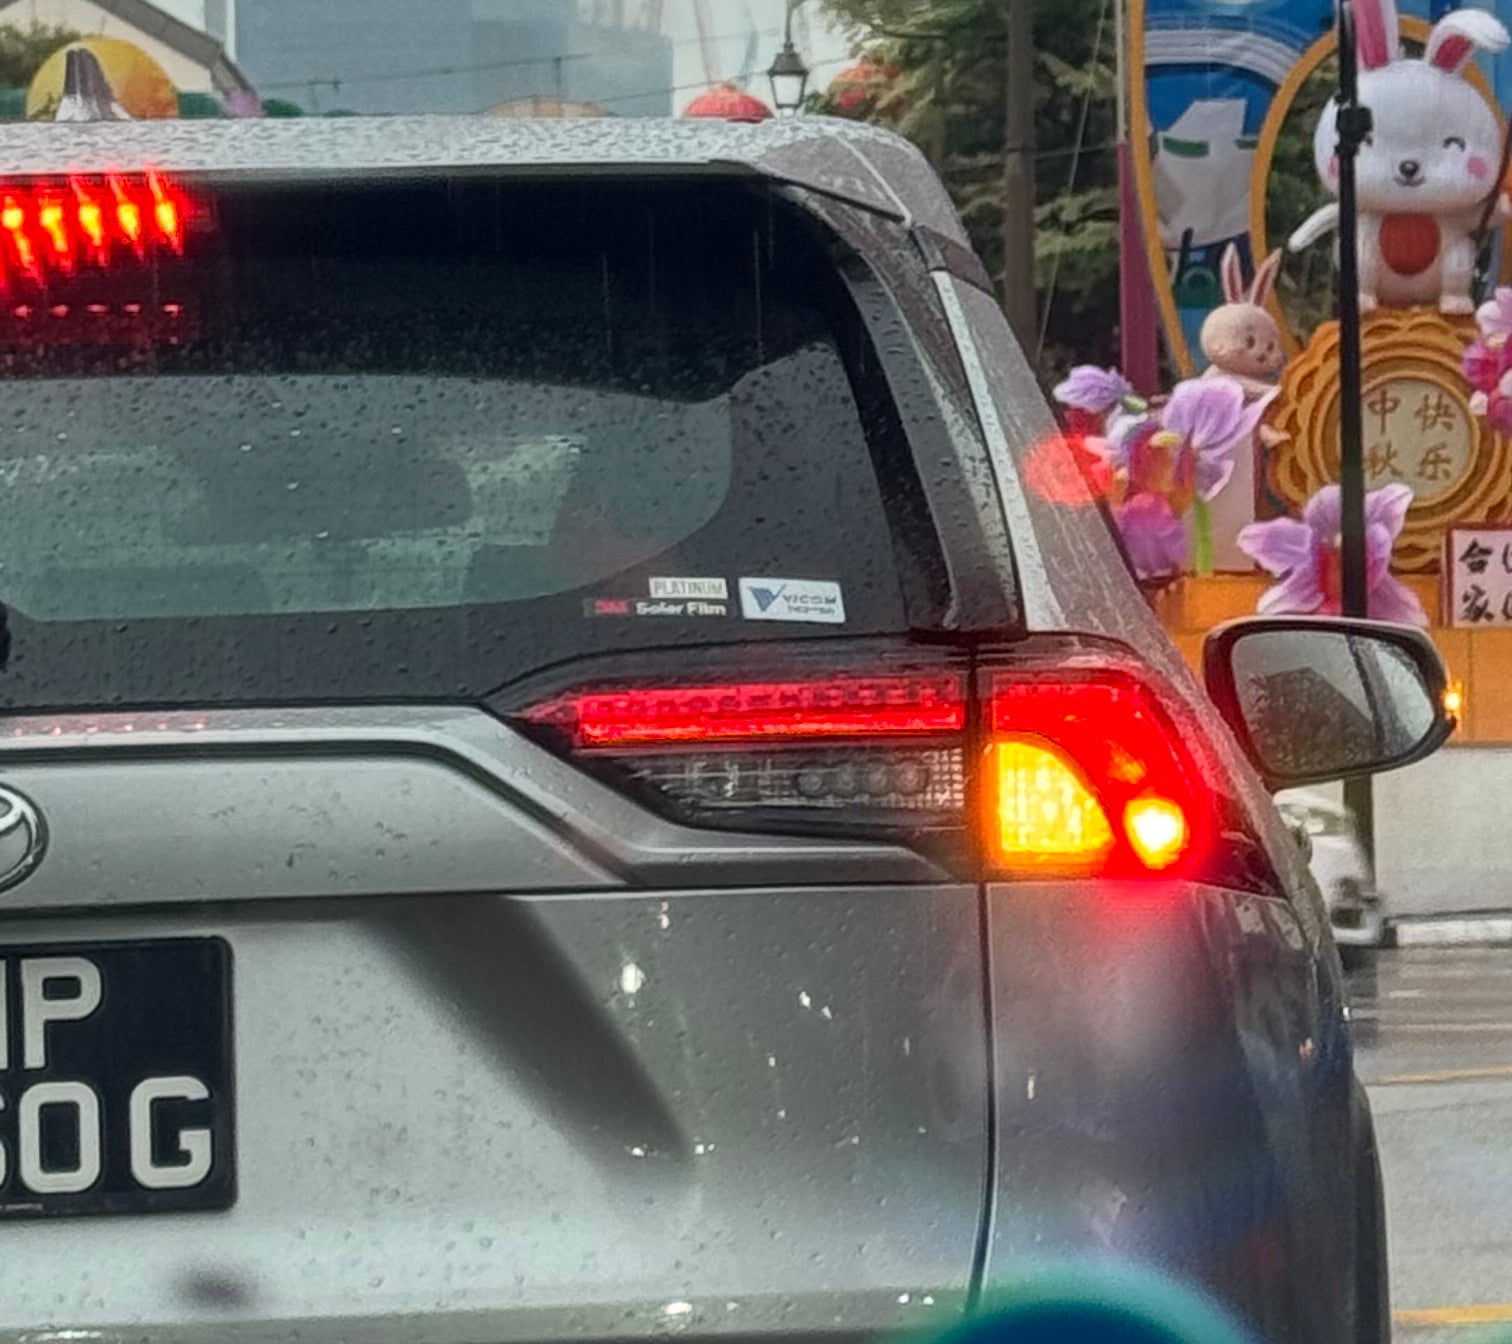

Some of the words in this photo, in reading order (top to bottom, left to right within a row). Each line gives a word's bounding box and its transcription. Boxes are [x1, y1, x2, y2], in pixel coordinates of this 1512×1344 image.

[653, 581, 724, 596] PLATINUM
[635, 602, 684, 616] Solar
[686, 602, 727, 616] Film
[0, 956, 102, 1070] P
